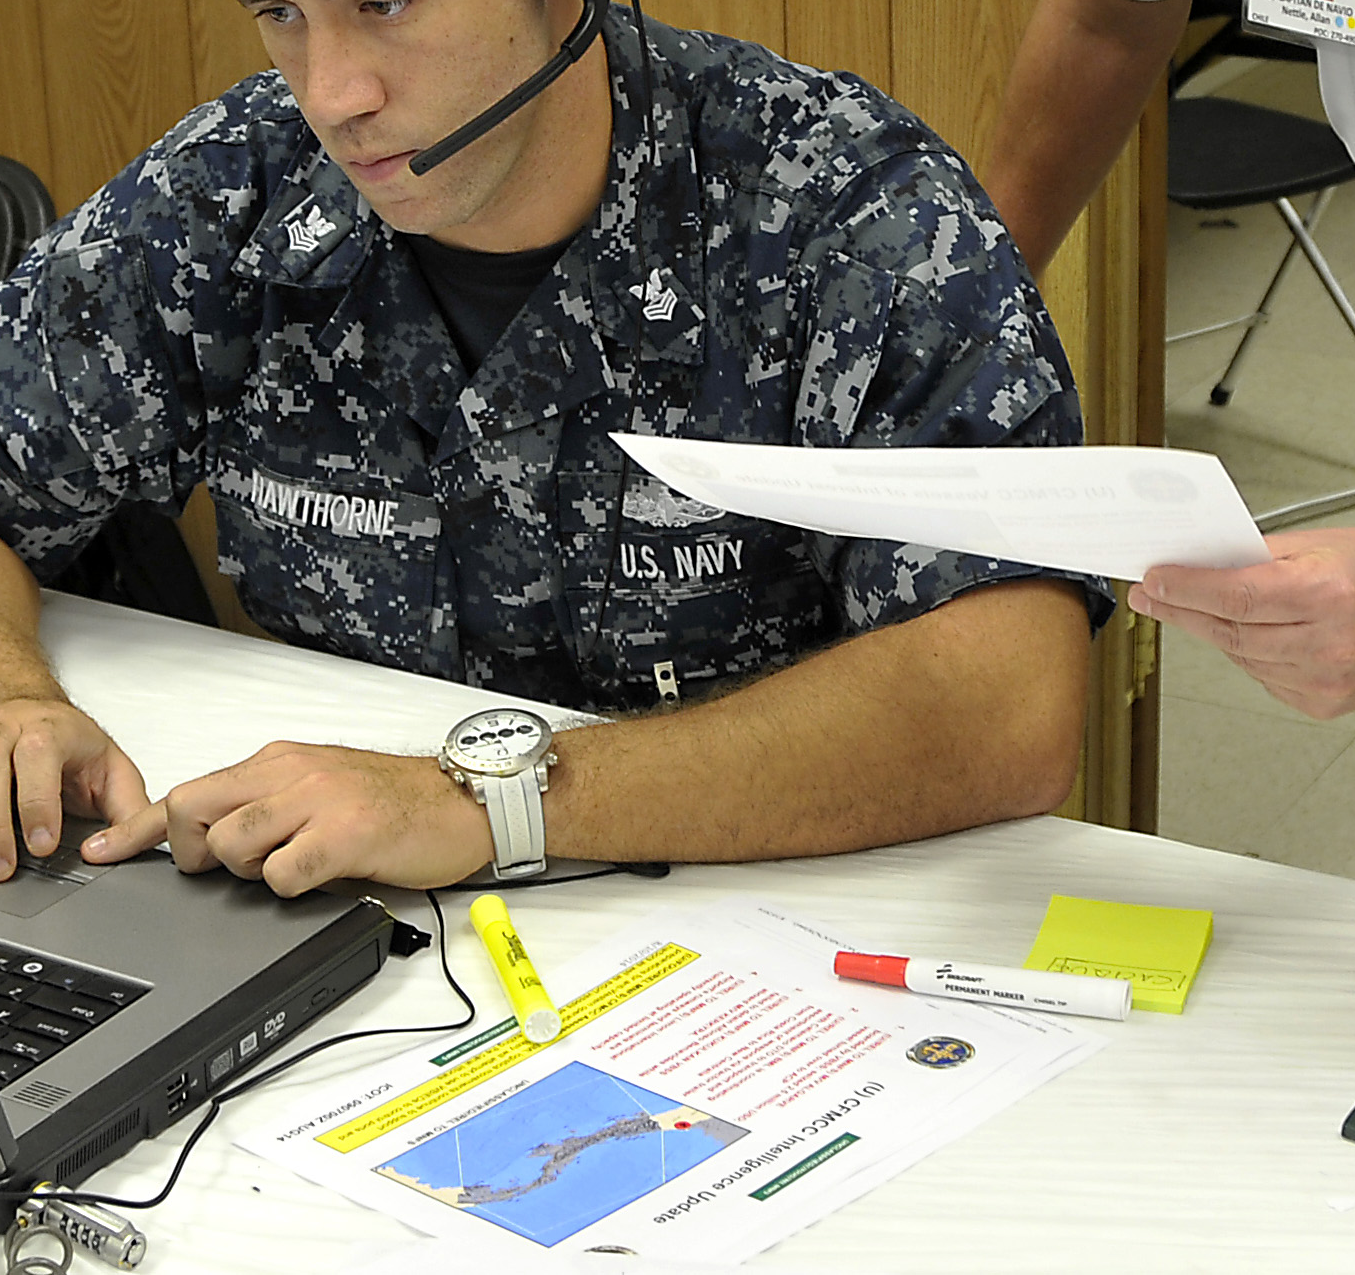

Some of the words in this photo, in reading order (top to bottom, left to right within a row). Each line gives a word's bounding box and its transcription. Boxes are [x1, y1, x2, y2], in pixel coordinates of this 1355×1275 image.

[1281, 5, 1308, 22] Nettle,
[1310, 10, 1331, 25] Allan
[1325, 0, 1354, 17] NAVIO
[251, 470, 399, 538] HAWTHORNE
[621, 543, 666, 579] U.S.
[674, 539, 744, 578] NAVY
[943, 982, 994, 999] PERMANENT
[994, 988, 1027, 1002] MARKER
[856, 1080, 885, 1100] (U)
[276, 1119, 316, 1144] AUG14
[801, 1096, 860, 1137] CFMCC
[714, 1134, 807, 1192] Intelligence
[654, 1189, 717, 1225] Update
